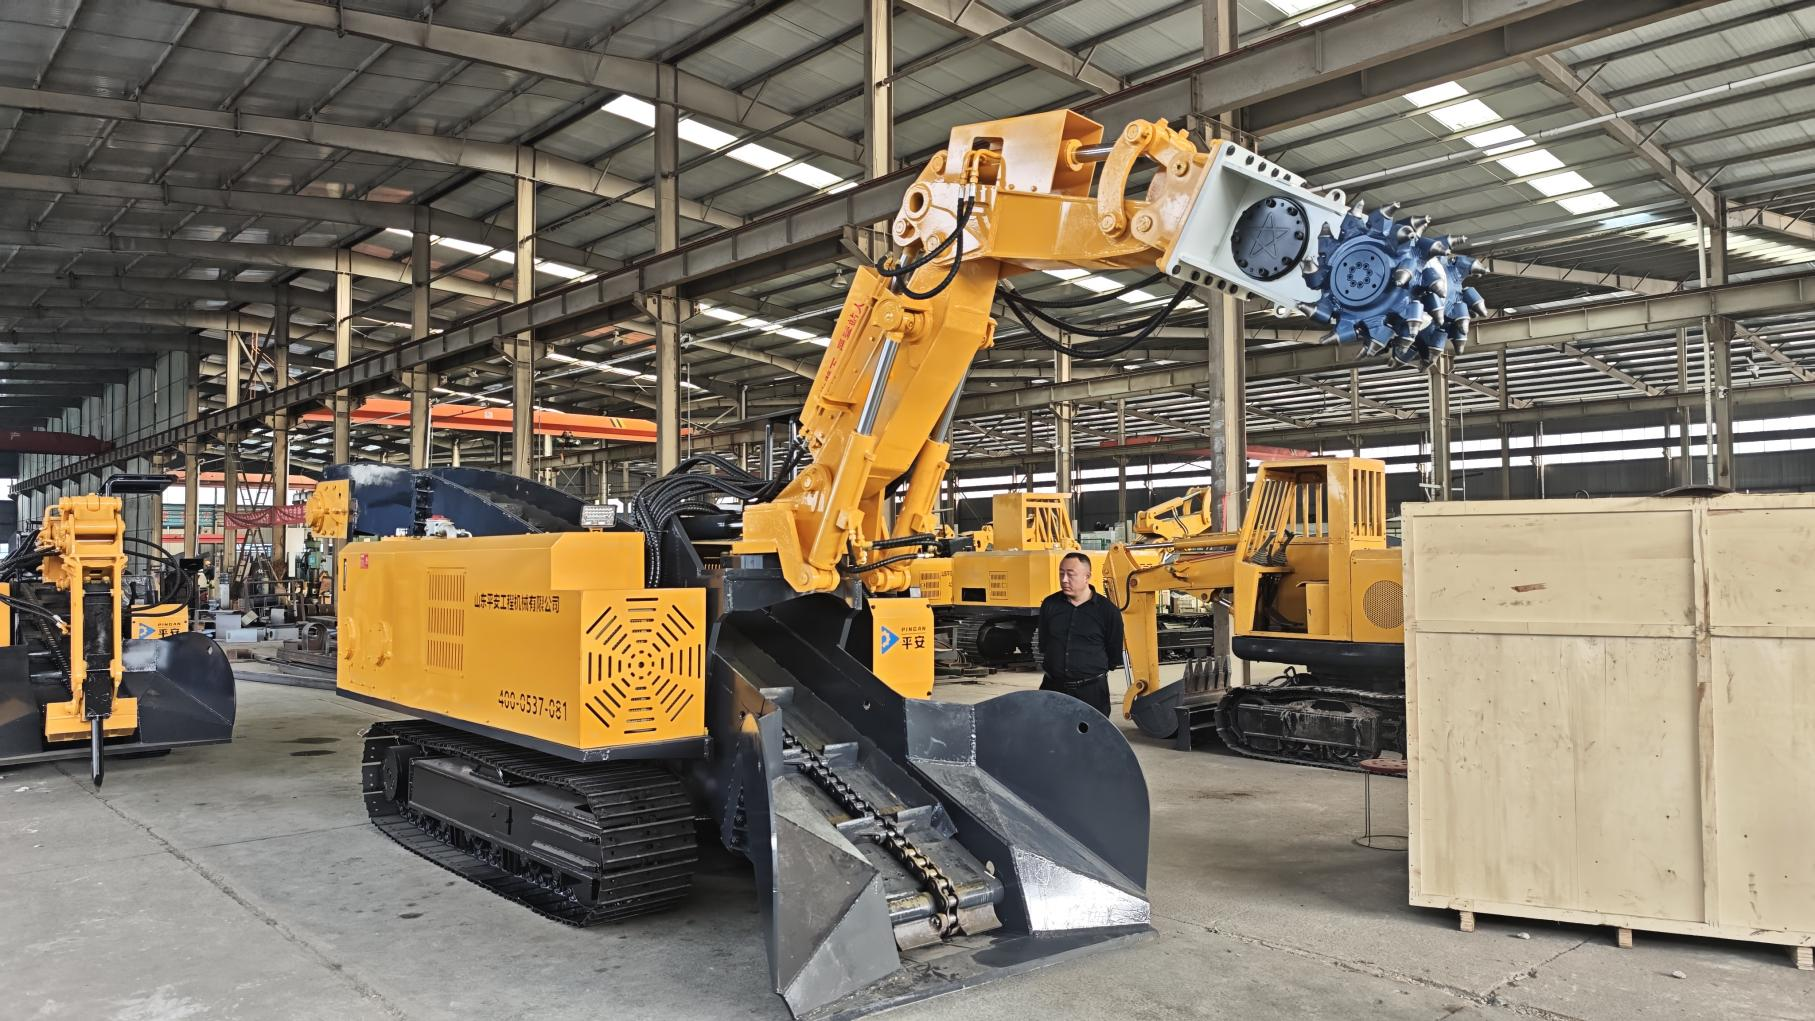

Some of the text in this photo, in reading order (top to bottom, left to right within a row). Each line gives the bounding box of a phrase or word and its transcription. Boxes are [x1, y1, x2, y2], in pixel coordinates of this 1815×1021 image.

[474, 592, 560, 614] 山东平安工程机械有限公司
[902, 635, 926, 650] 平安
[498, 689, 567, 721] 400-0537-081
